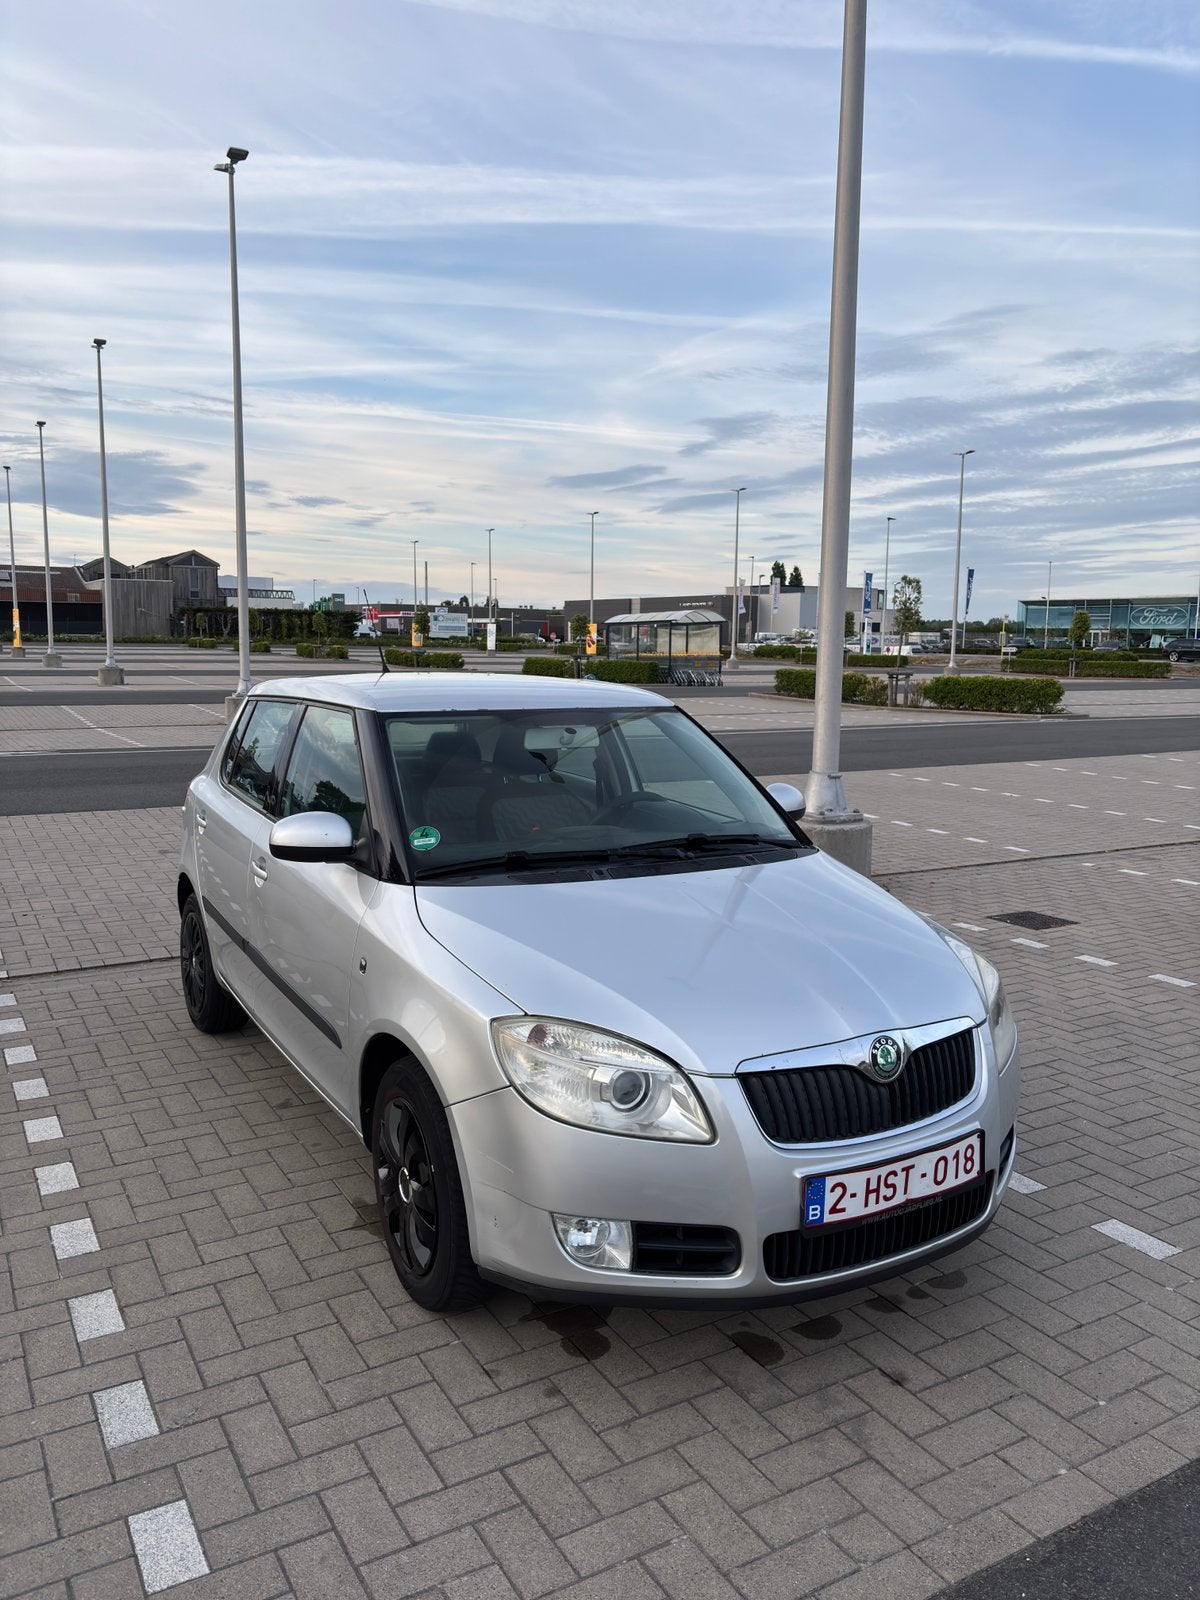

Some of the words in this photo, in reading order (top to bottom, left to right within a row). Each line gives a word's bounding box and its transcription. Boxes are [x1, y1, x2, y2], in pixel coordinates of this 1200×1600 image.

[1139, 607, 1178, 625] Ford
[420, 827, 430, 838] 4
[808, 1204, 821, 1221] B
